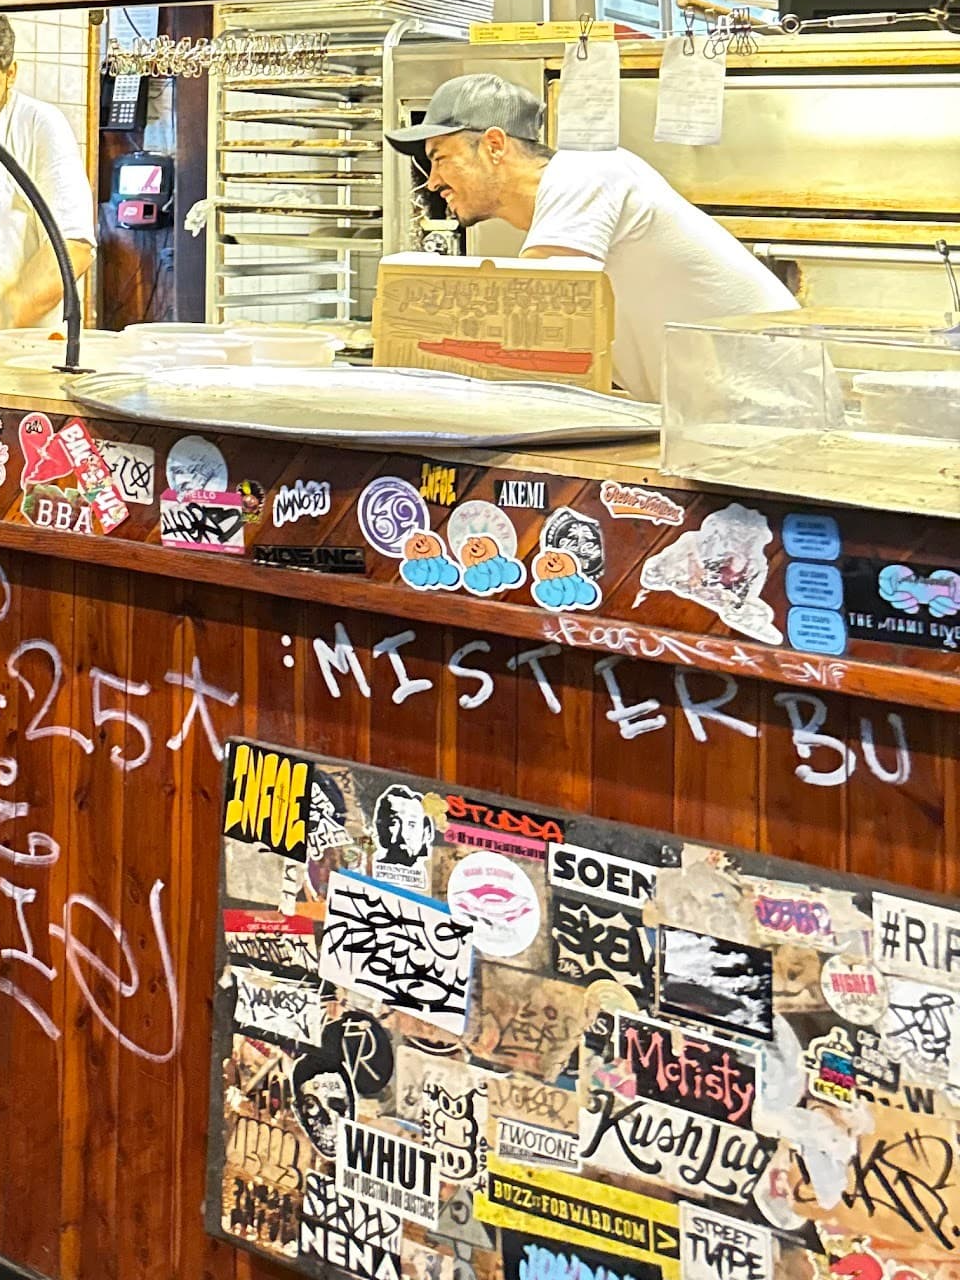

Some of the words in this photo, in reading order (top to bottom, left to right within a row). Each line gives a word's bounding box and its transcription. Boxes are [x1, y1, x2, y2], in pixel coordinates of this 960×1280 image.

[36, 499, 92, 534] BBA
[498, 480, 545, 509] AKEMI
[849, 613, 873, 628] THE
[314, 623, 760, 741] MISTER
[224, 745, 308, 851] INFOE
[624, 1026, 754, 1123] McFisty
[345, 1124, 436, 1196] WHUT
[500, 1122, 577, 1160] TWOTONE
[302, 1222, 399, 1280] NENA
